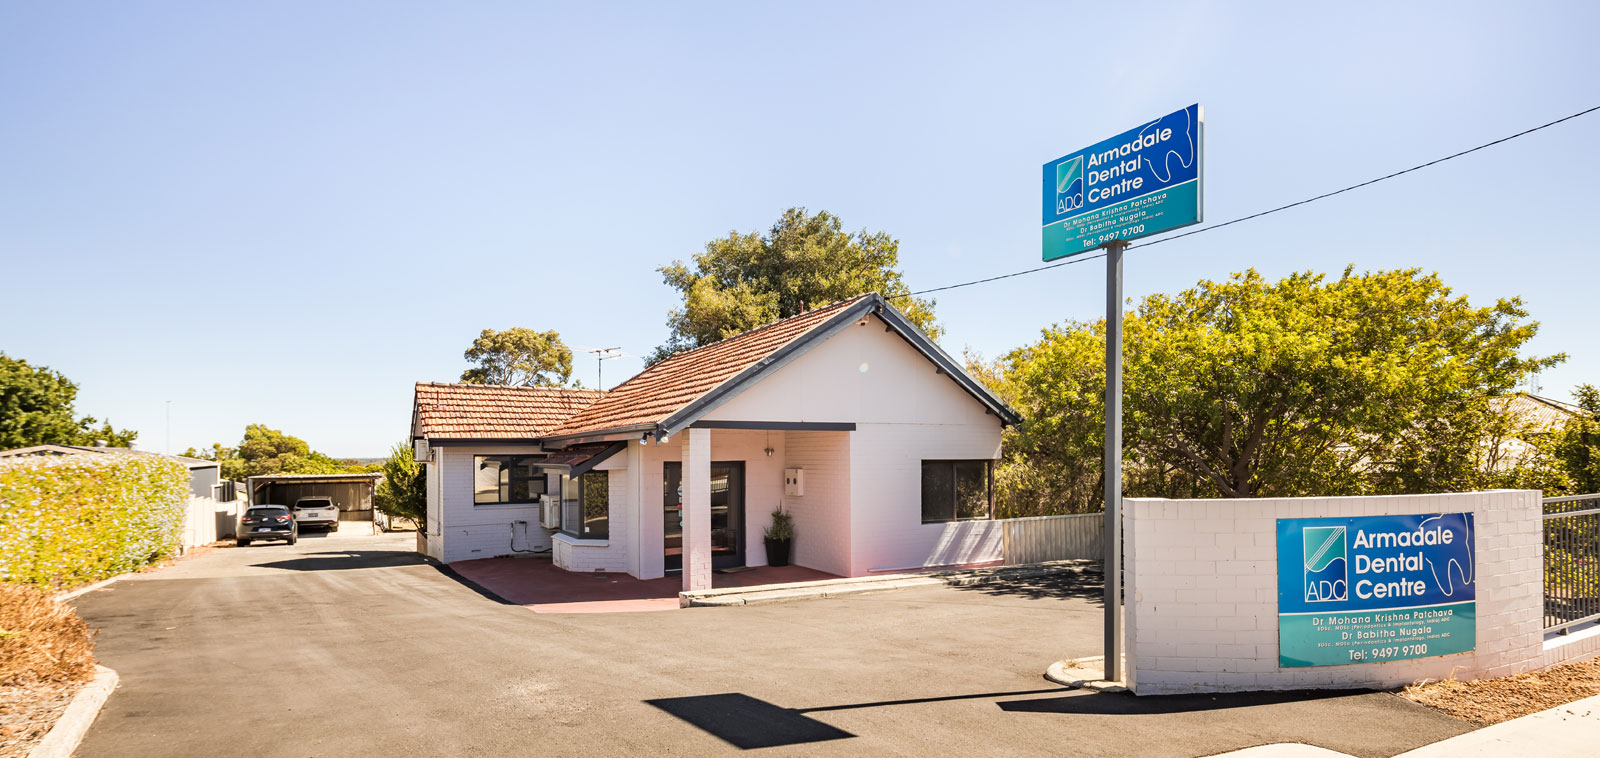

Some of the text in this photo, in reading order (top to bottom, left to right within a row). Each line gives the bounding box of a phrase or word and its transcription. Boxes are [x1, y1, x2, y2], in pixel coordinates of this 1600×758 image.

[1087, 128, 1172, 169] Armadale
[1088, 154, 1142, 186] Dental
[1088, 177, 1144, 203] Centre
[1058, 193, 1082, 212] ADC
[1072, 214, 1100, 226] Mohana
[1102, 205, 1128, 216] Krishna
[1130, 194, 1166, 208] Patchava
[1090, 220, 1116, 231] Babitha
[1120, 210, 1146, 222] Nugala
[1083, 238, 1096, 247] Tel:
[1098, 230, 1120, 243] 9497
[1122, 224, 1144, 237] 9700
[1353, 526, 1454, 549] Armadale
[1355, 552, 1423, 574] Dental
[1306, 579, 1346, 600] ADC
[1355, 578, 1426, 600] Centre
[1312, 610, 1453, 626] Dr Mohana Krishna Patchava
[1342, 626, 1432, 640] Dr Babitha Nugala
[1349, 644, 1428, 660] Tel: 9497 9700
